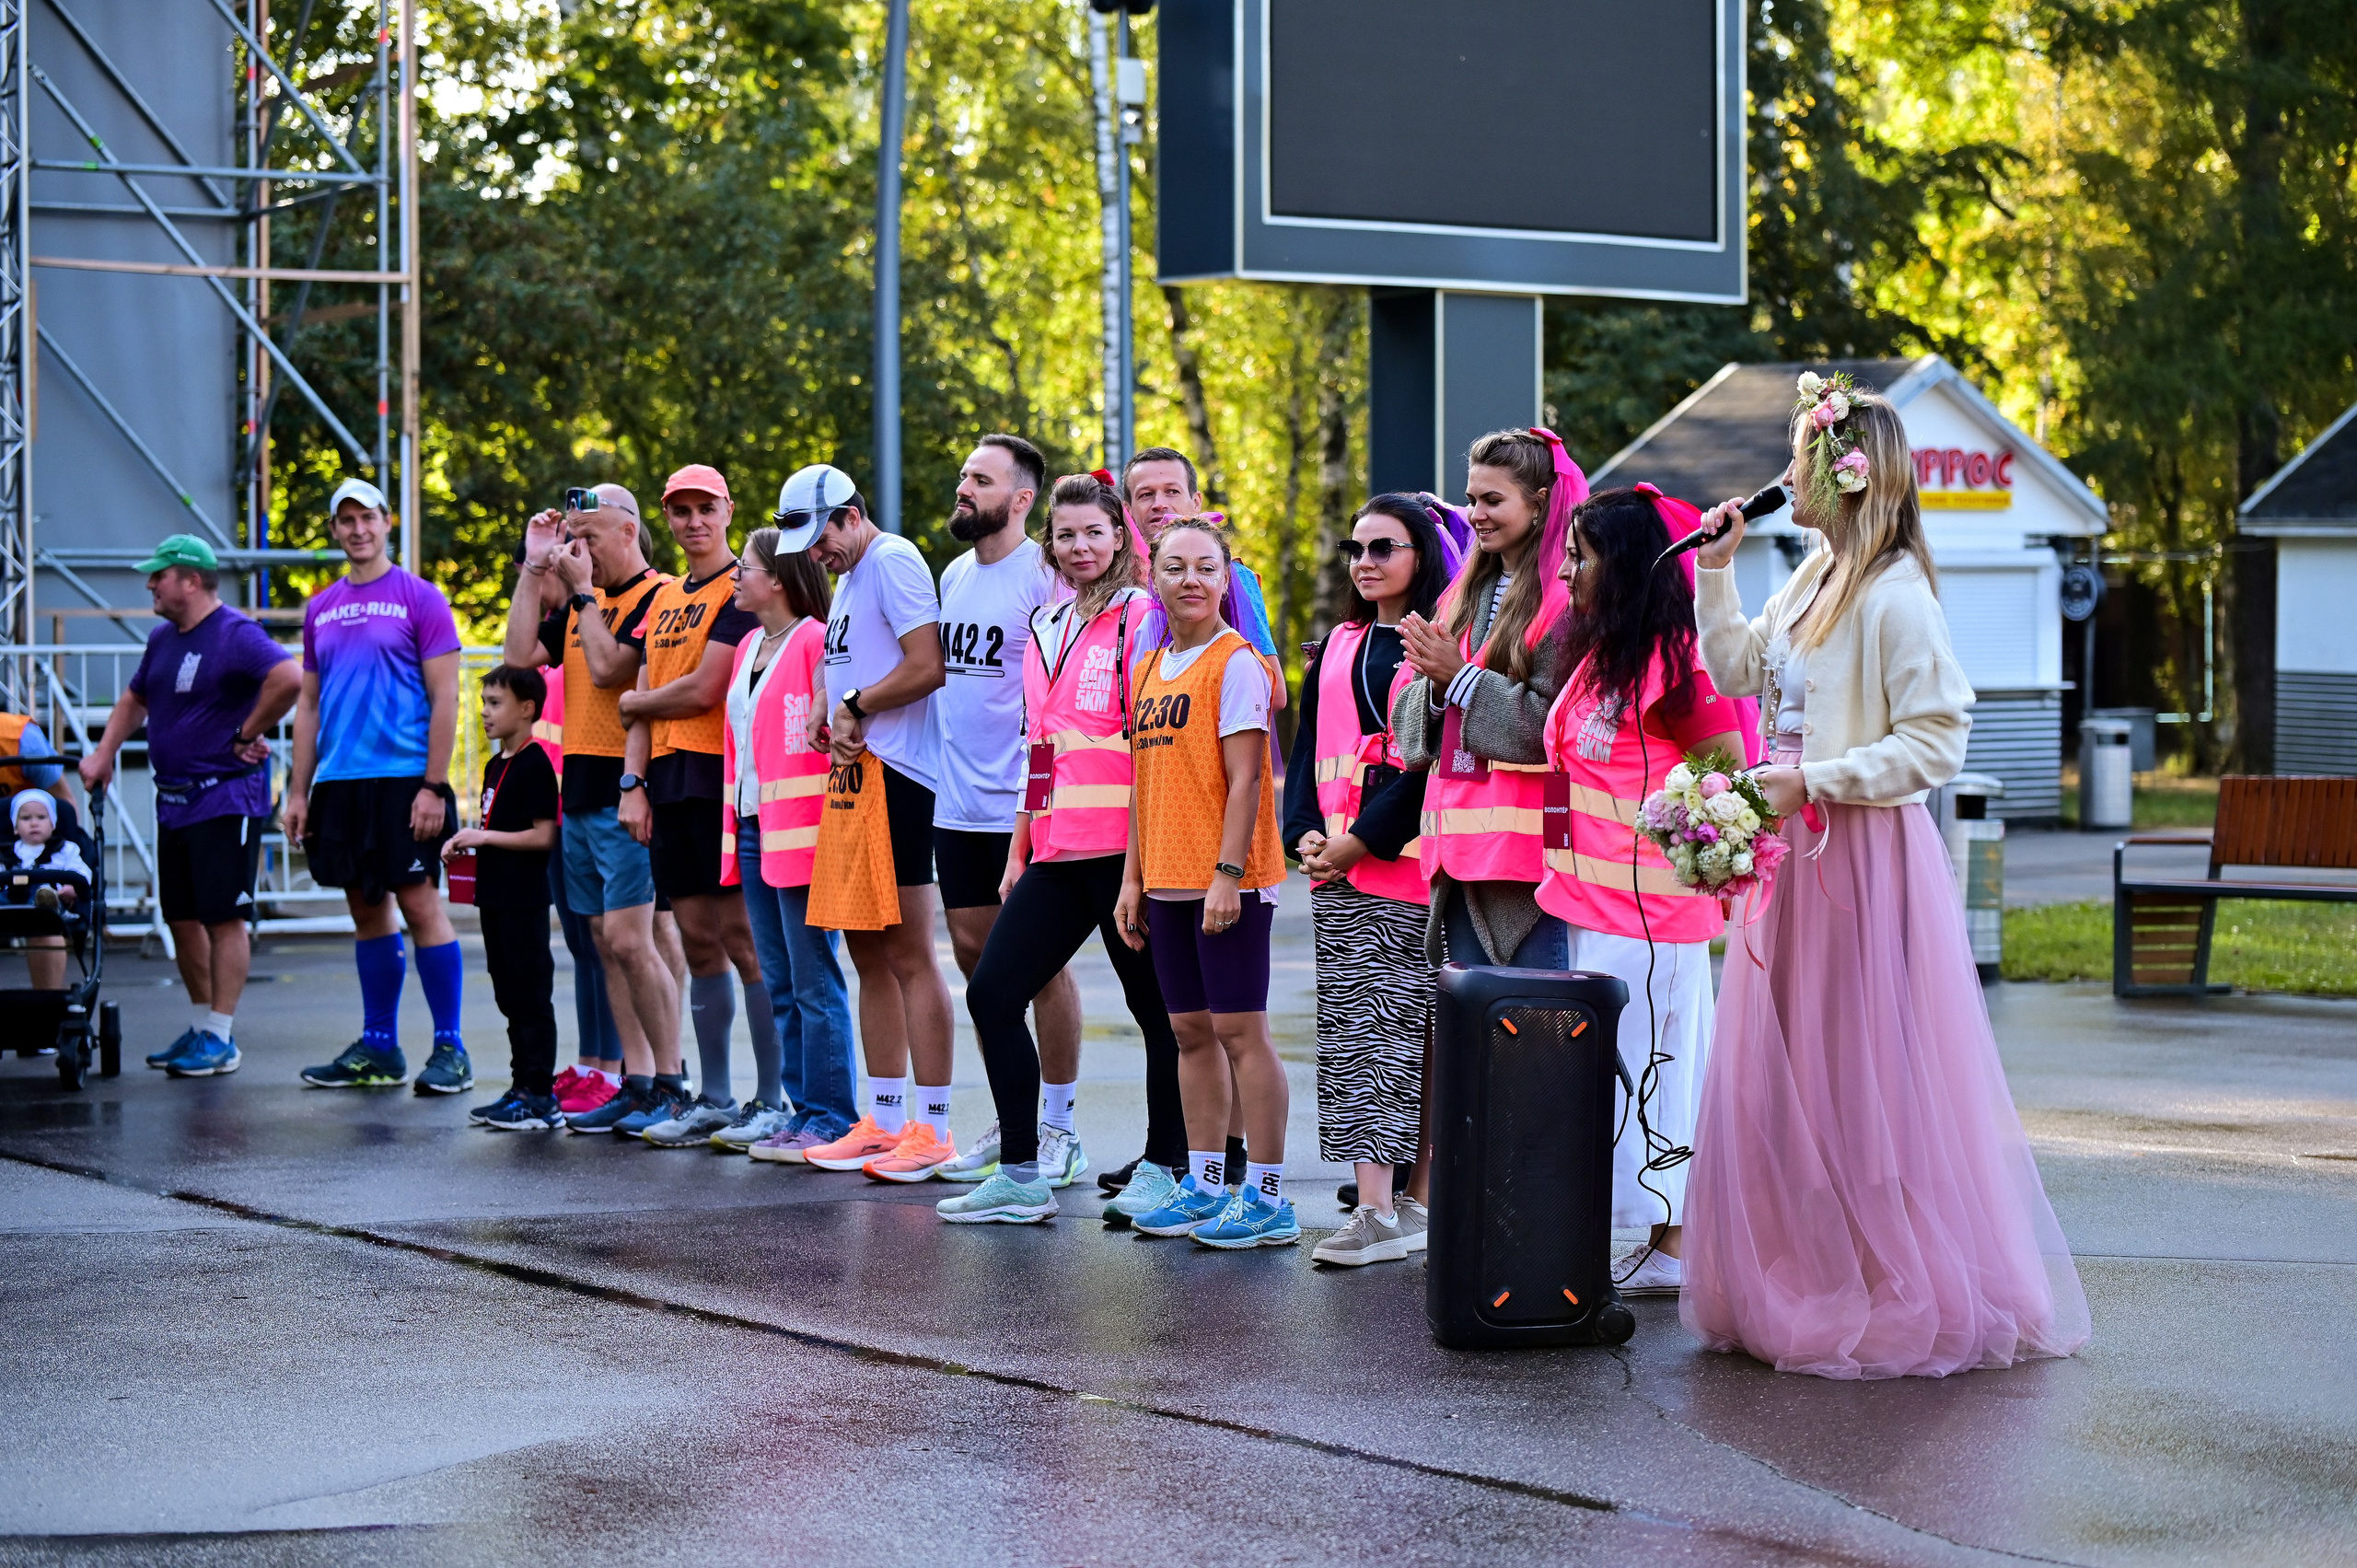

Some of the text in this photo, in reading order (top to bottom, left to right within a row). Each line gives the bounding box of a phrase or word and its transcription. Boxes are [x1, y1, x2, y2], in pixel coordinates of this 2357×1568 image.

[1084, 645, 1117, 670] Sat
[1078, 668, 1113, 691] 9AM
[784, 693, 810, 718] Sat
[1075, 690, 1109, 713] 5KM
[1576, 731, 1612, 764] 5KM
